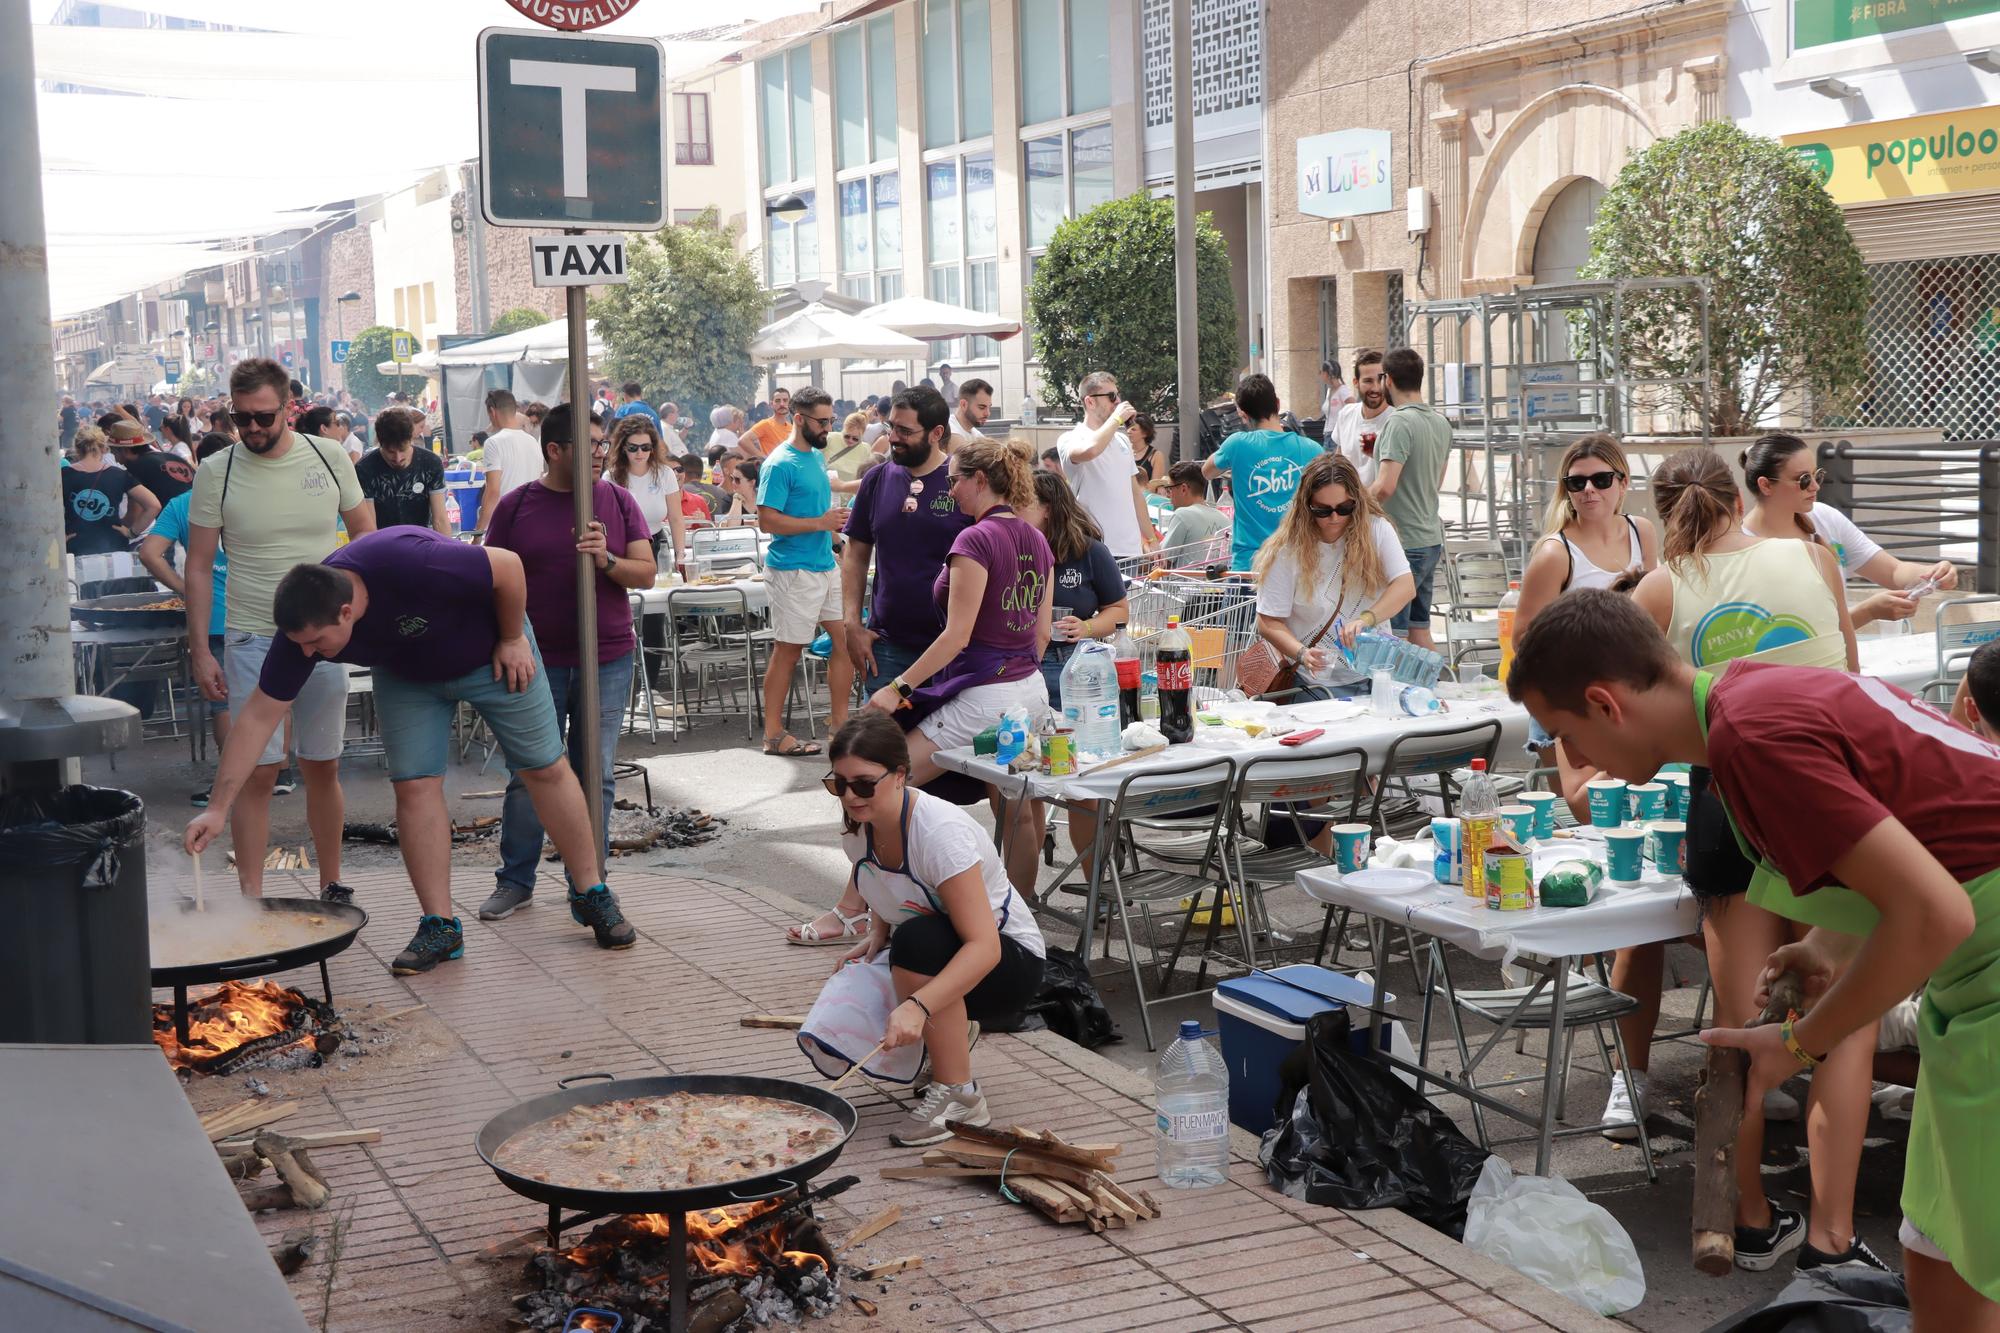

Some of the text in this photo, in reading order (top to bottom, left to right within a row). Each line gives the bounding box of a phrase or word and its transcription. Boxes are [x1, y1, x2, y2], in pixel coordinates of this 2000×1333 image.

[1863, 2, 1907, 20] FIBRA
[509, 58, 637, 198] T
[535, 244, 624, 277] TAXI
[1707, 625, 1755, 650] PENYA
